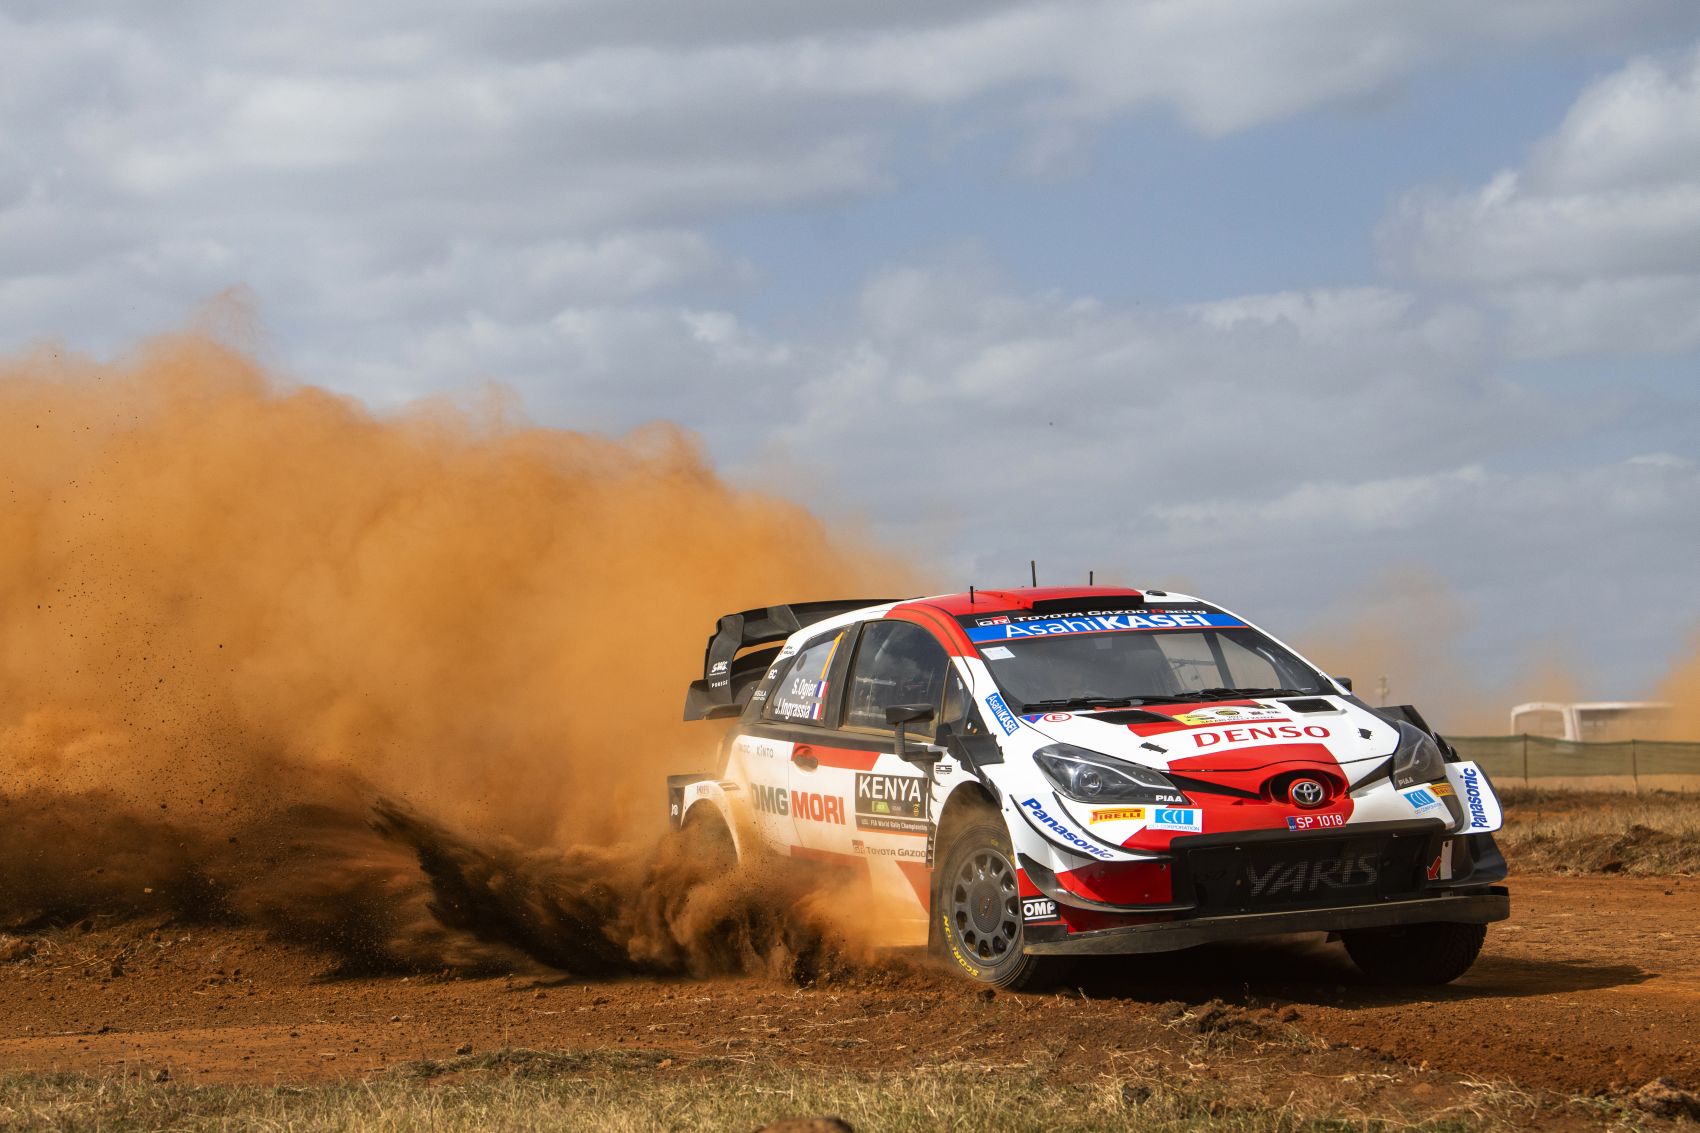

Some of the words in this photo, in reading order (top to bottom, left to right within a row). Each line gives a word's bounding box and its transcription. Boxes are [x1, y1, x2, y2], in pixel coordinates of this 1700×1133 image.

[1006, 614, 1212, 638] AsahiKASEI
[1014, 611, 1084, 622] TOYOTA
[1087, 608, 1148, 616] GAZOO
[792, 678, 818, 699] S.Ogier
[774, 700, 811, 720] J.Ingrassia
[987, 695, 1018, 734] AsahiKASEI
[1192, 725, 1331, 747] DENSO
[751, 782, 789, 815] DMG
[859, 775, 921, 802] KENYA
[1460, 768, 1490, 828] Panasonic
[791, 790, 846, 825] MORI
[1092, 809, 1142, 822] PIRELLI
[1021, 798, 1115, 859] Panasonic
[1296, 816, 1313, 828] SP
[1317, 814, 1343, 826] 1018
[866, 846, 896, 857] TOYOTA
[897, 848, 926, 858] GAZOO
[1246, 855, 1378, 896] YARIS
[1023, 901, 1056, 917] OMP
